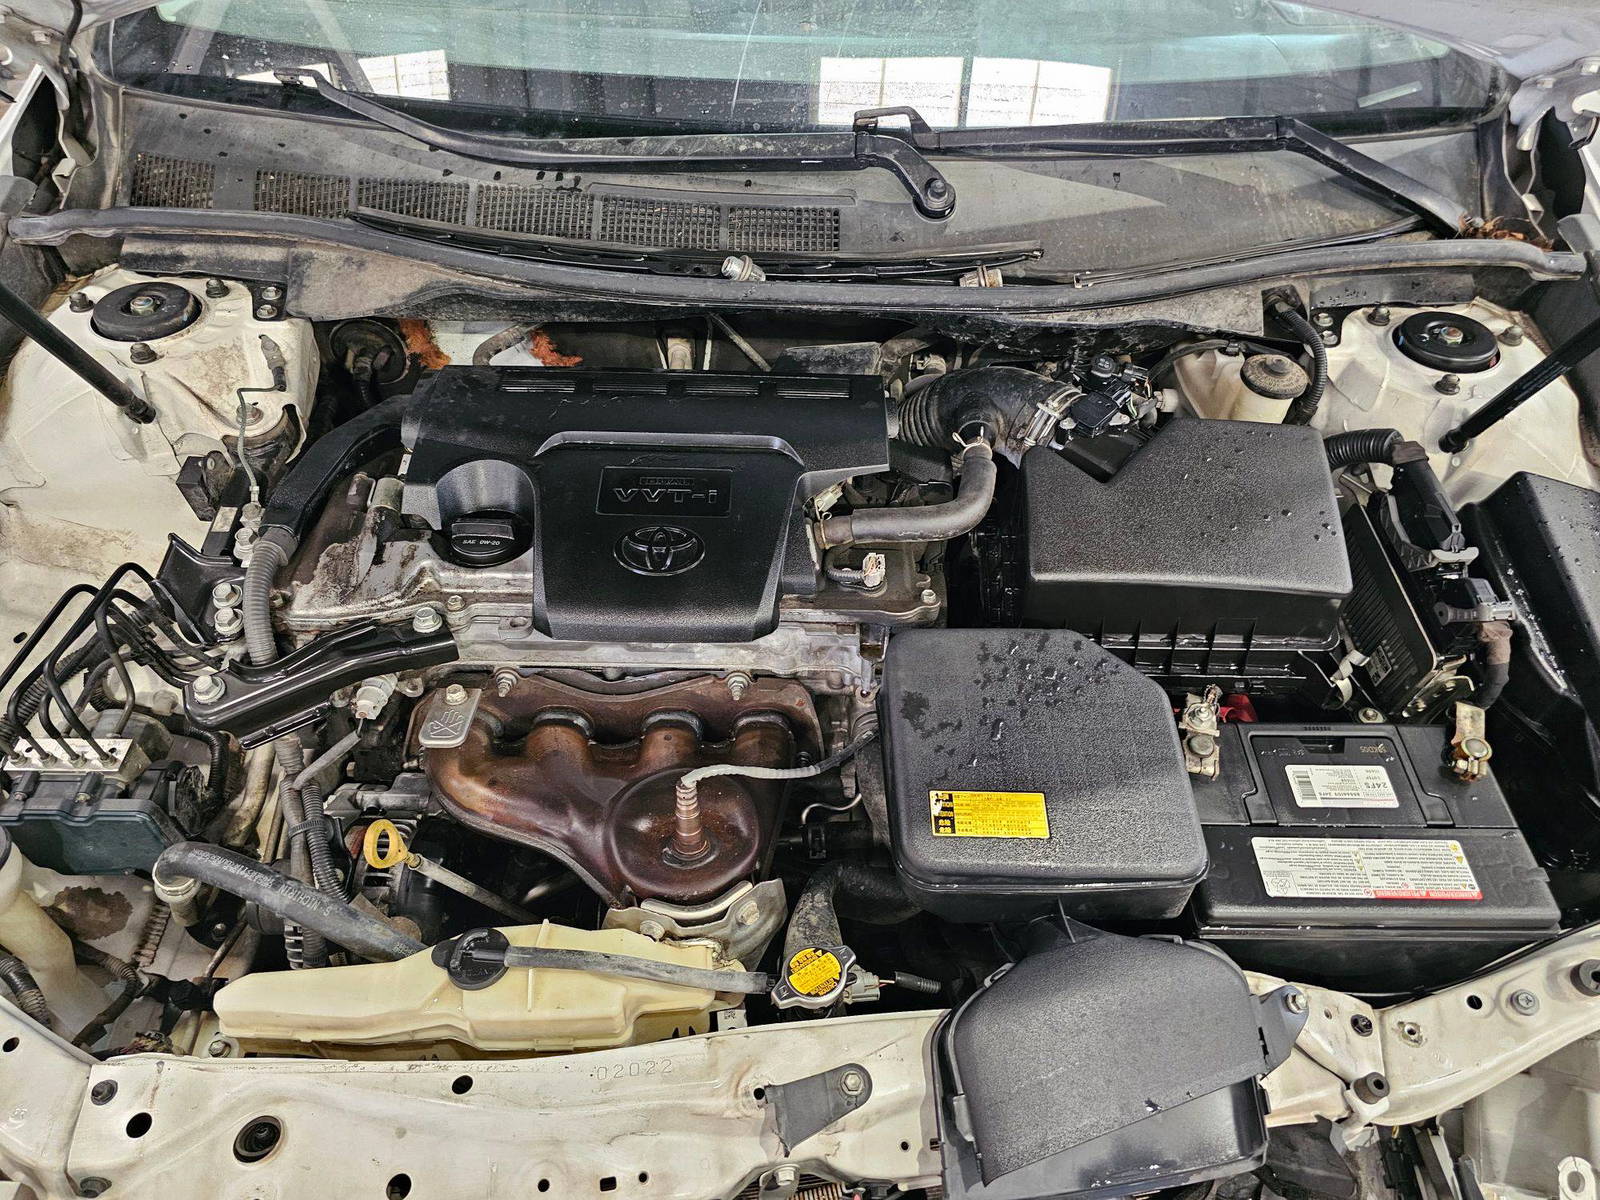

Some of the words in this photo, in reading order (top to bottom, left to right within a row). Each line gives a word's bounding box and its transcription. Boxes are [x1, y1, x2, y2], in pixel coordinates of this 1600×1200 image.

[613, 488, 718, 504] VVT-i
[278, 883, 320, 911] NICHIRIN
[597, 1059, 672, 1080] 02022
